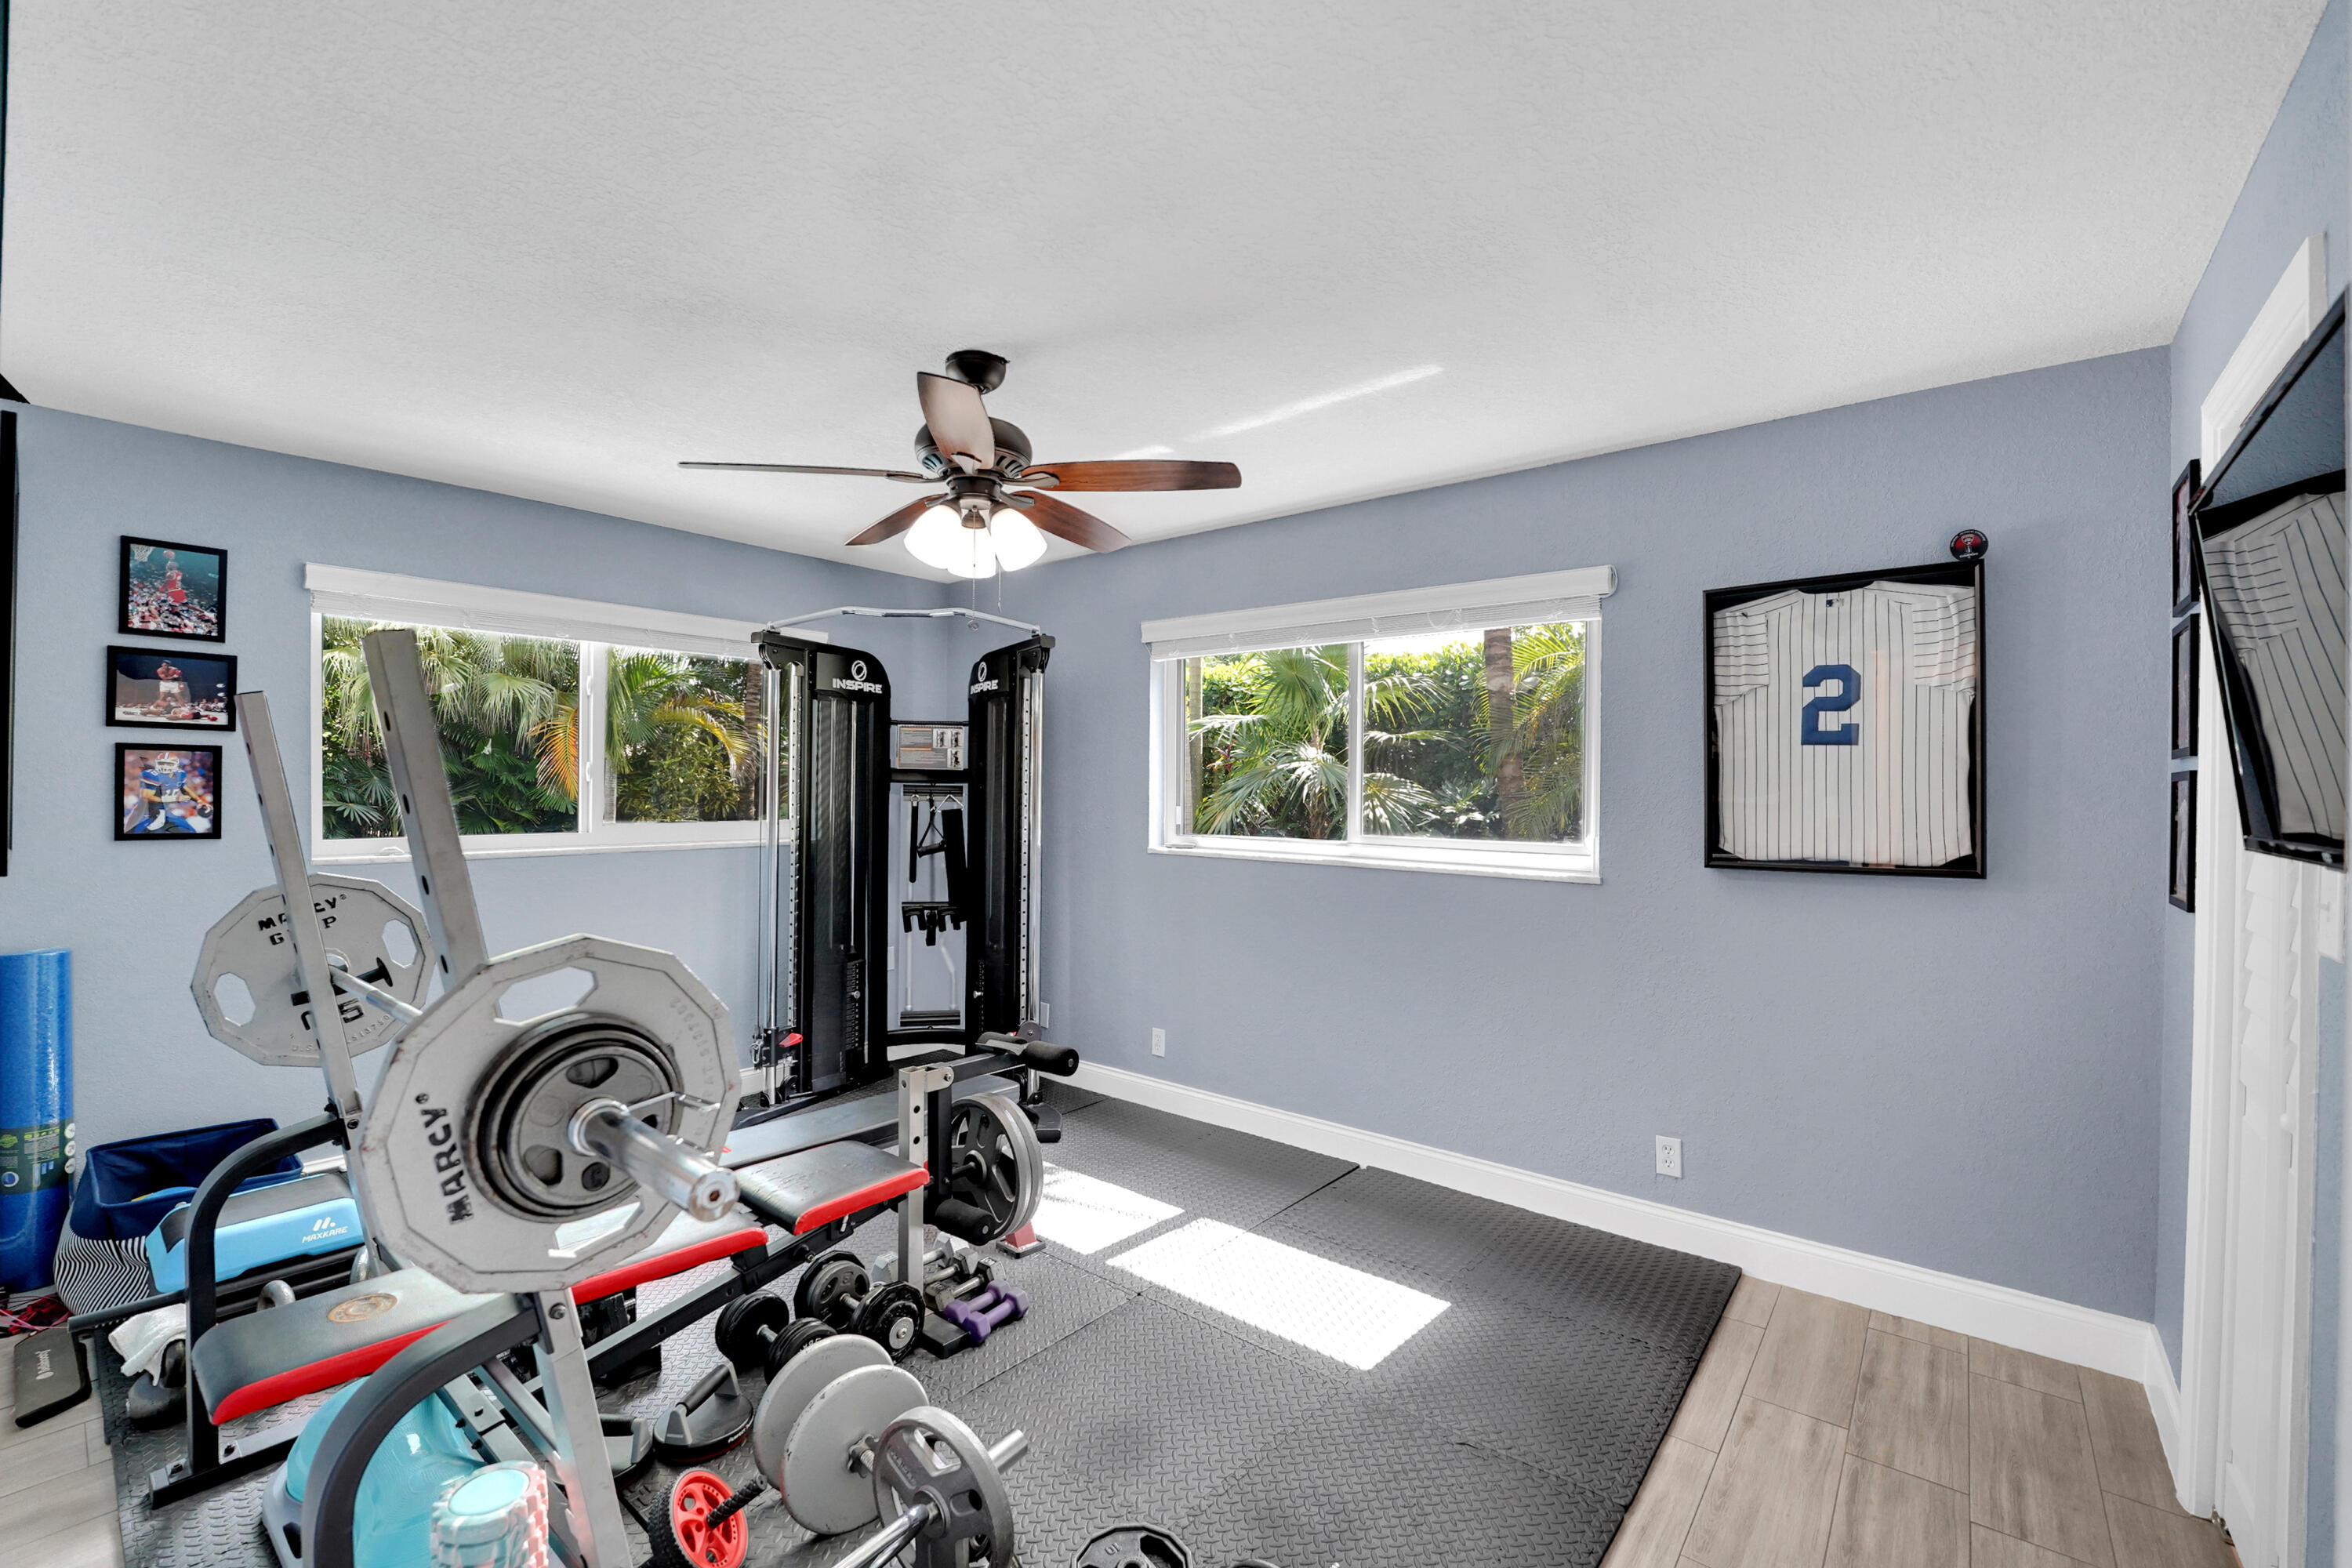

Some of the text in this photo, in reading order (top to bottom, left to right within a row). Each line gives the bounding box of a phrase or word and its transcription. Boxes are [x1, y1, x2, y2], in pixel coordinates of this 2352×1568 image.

[833, 678, 882, 694] INSPIRE
[1802, 665, 1860, 745] 2
[302, 1226, 348, 1243] MAXKARE
